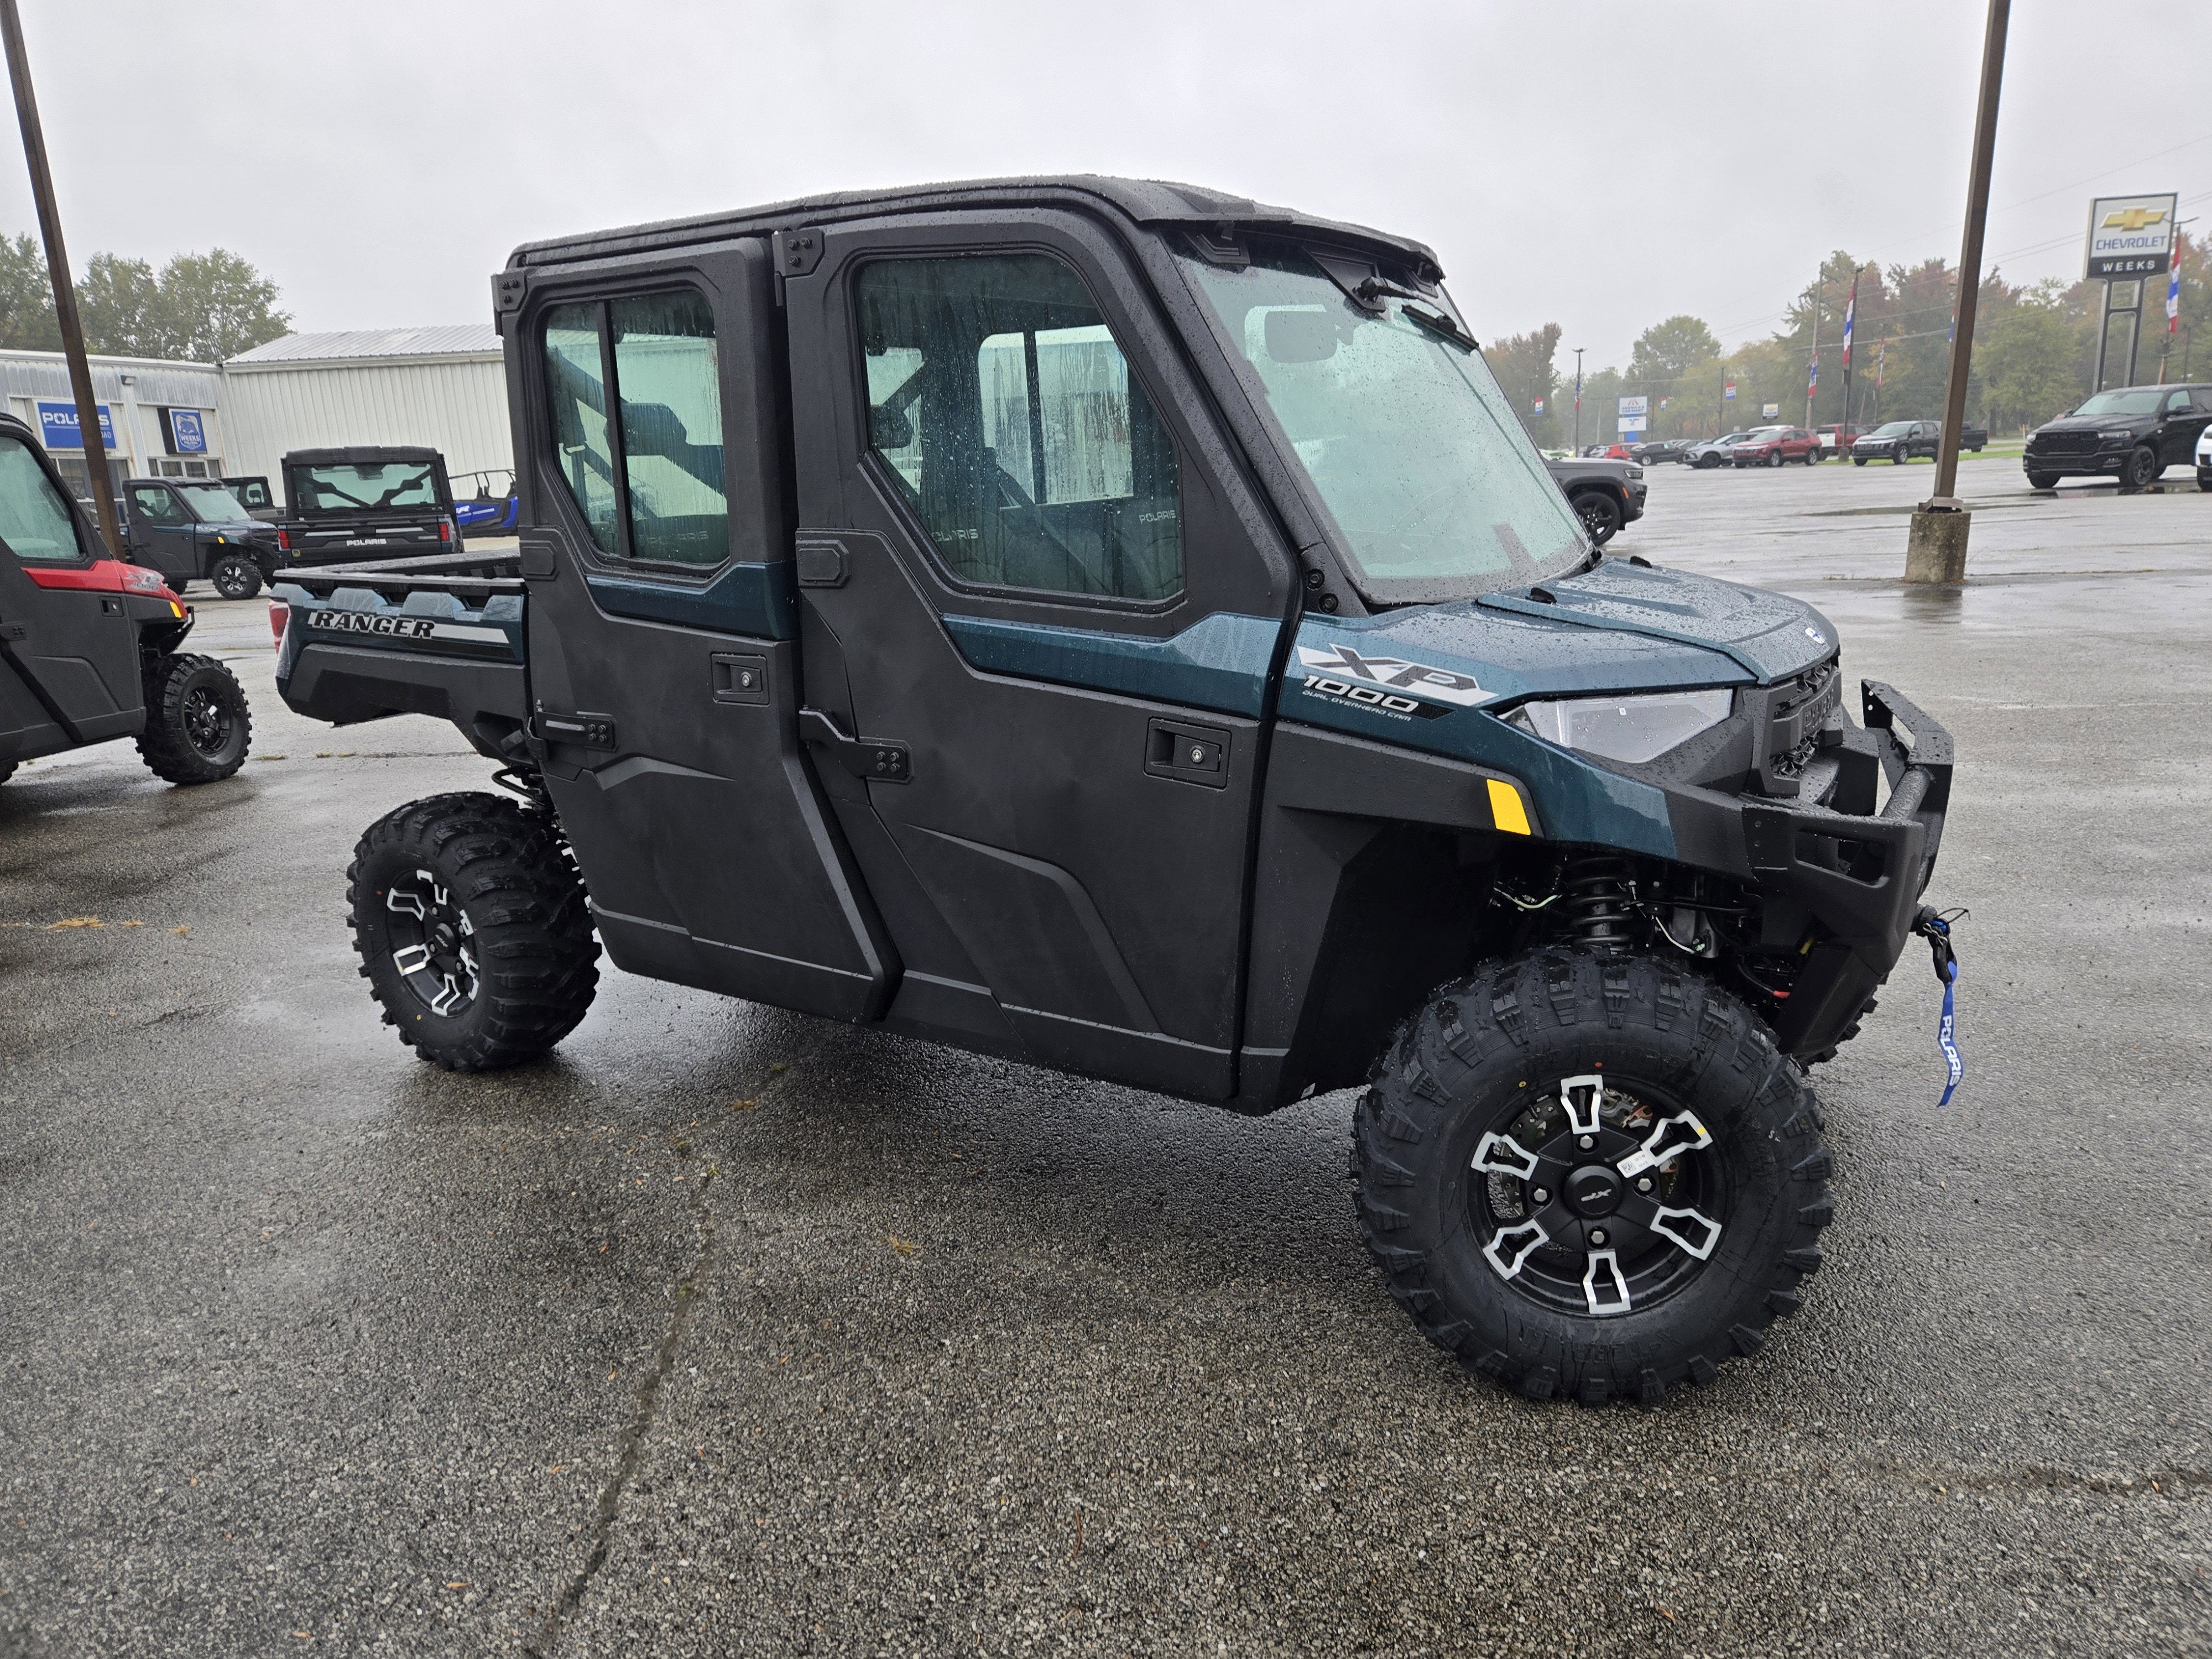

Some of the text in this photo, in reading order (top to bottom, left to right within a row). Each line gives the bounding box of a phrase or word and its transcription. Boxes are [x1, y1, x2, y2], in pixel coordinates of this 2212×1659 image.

[2096, 236, 2167, 250] CHEVROLET
[2103, 260, 2156, 272] WEEKS
[41, 412, 109, 426] POLAS
[1139, 510, 1176, 525] POLARIS
[931, 529, 978, 541] OLARIS
[312, 610, 435, 640] RANGER
[1302, 644, 1482, 691] XP
[1303, 675, 1418, 712] 1000
[1302, 690, 1411, 722] DUAL OVERHEAD CAM
[1940, 1015, 1961, 1087] POLARIS
